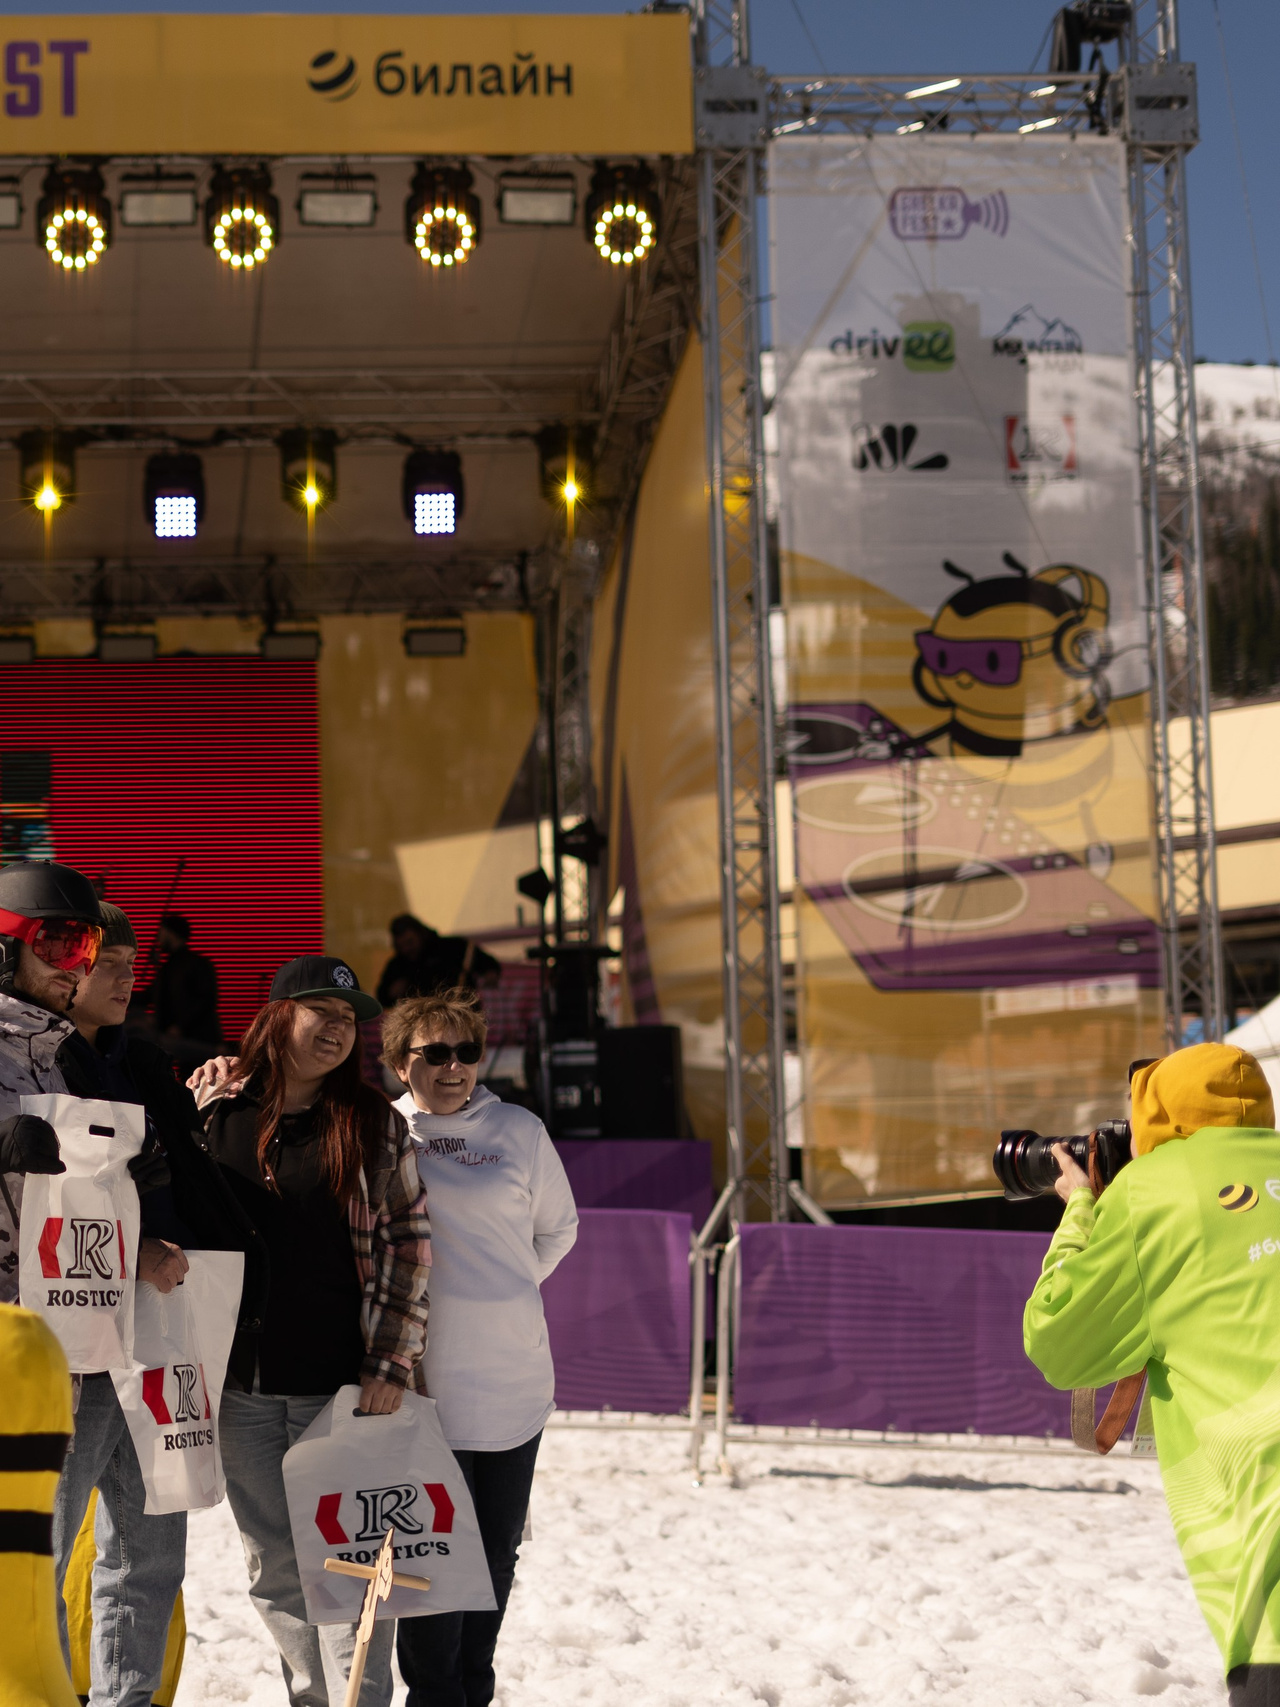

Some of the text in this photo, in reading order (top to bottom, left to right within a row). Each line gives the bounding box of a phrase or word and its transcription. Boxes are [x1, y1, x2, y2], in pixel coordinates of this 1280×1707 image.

[374, 51, 572, 96] билайн
[429, 1138, 467, 1155] DETROIT
[65, 1218, 114, 1280] R
[47, 1289, 123, 1306] ROSTIC'
[164, 1429, 213, 1451] ROSTIC'S
[355, 1484, 424, 1542] R
